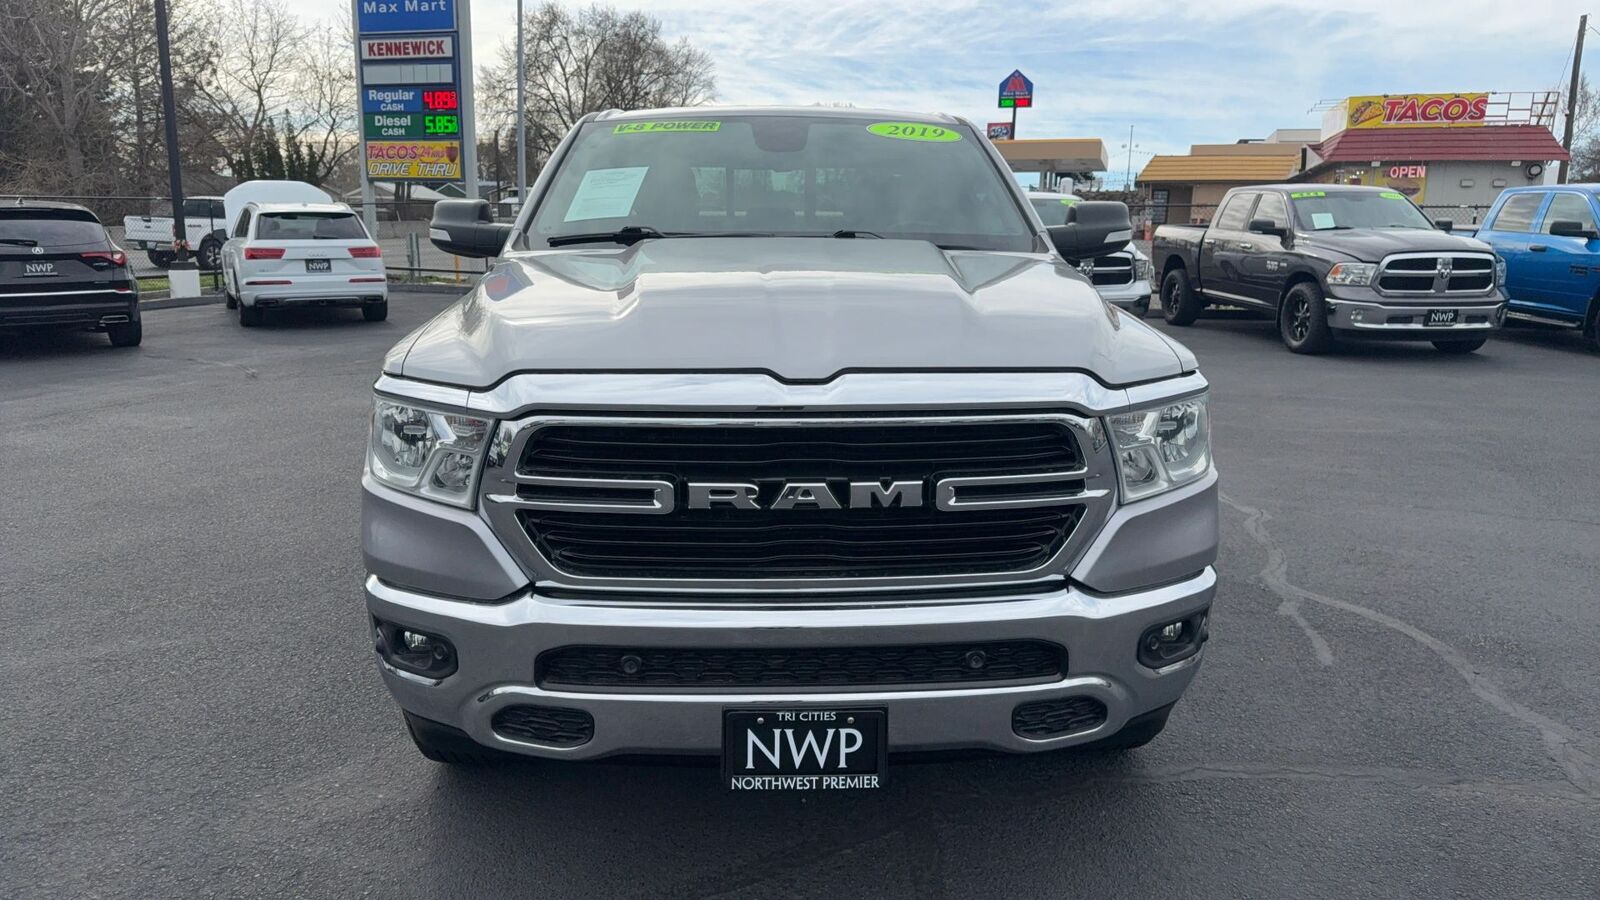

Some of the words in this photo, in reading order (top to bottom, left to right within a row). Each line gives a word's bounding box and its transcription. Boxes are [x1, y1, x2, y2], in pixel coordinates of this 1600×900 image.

[363, 1, 398, 14] Max
[404, 0, 446, 12] Mart
[367, 40, 446, 57] KENNEWICK
[368, 89, 415, 103] Regular
[380, 103, 405, 111] CASH
[1383, 97, 1488, 123] TACOS
[374, 115, 411, 126] Diesel
[649, 121, 717, 130] POWER
[381, 127, 405, 136] CASH
[887, 125, 946, 138] 2019
[368, 145, 418, 159] TACOS
[368, 162, 411, 176] DRIVE
[418, 163, 457, 177] THRU
[1390, 165, 1426, 178] OPEN
[25, 263, 54, 273] NWP
[308, 262, 329, 270] NWP
[1430, 312, 1454, 322] NWP
[687, 480, 923, 510] RAM
[776, 712, 796, 722] TRI
[799, 711, 837, 722] CITIES
[745, 728, 863, 770] NWP
[731, 776, 819, 790] NORTHWEST
[822, 775, 880, 790] PREMIER
